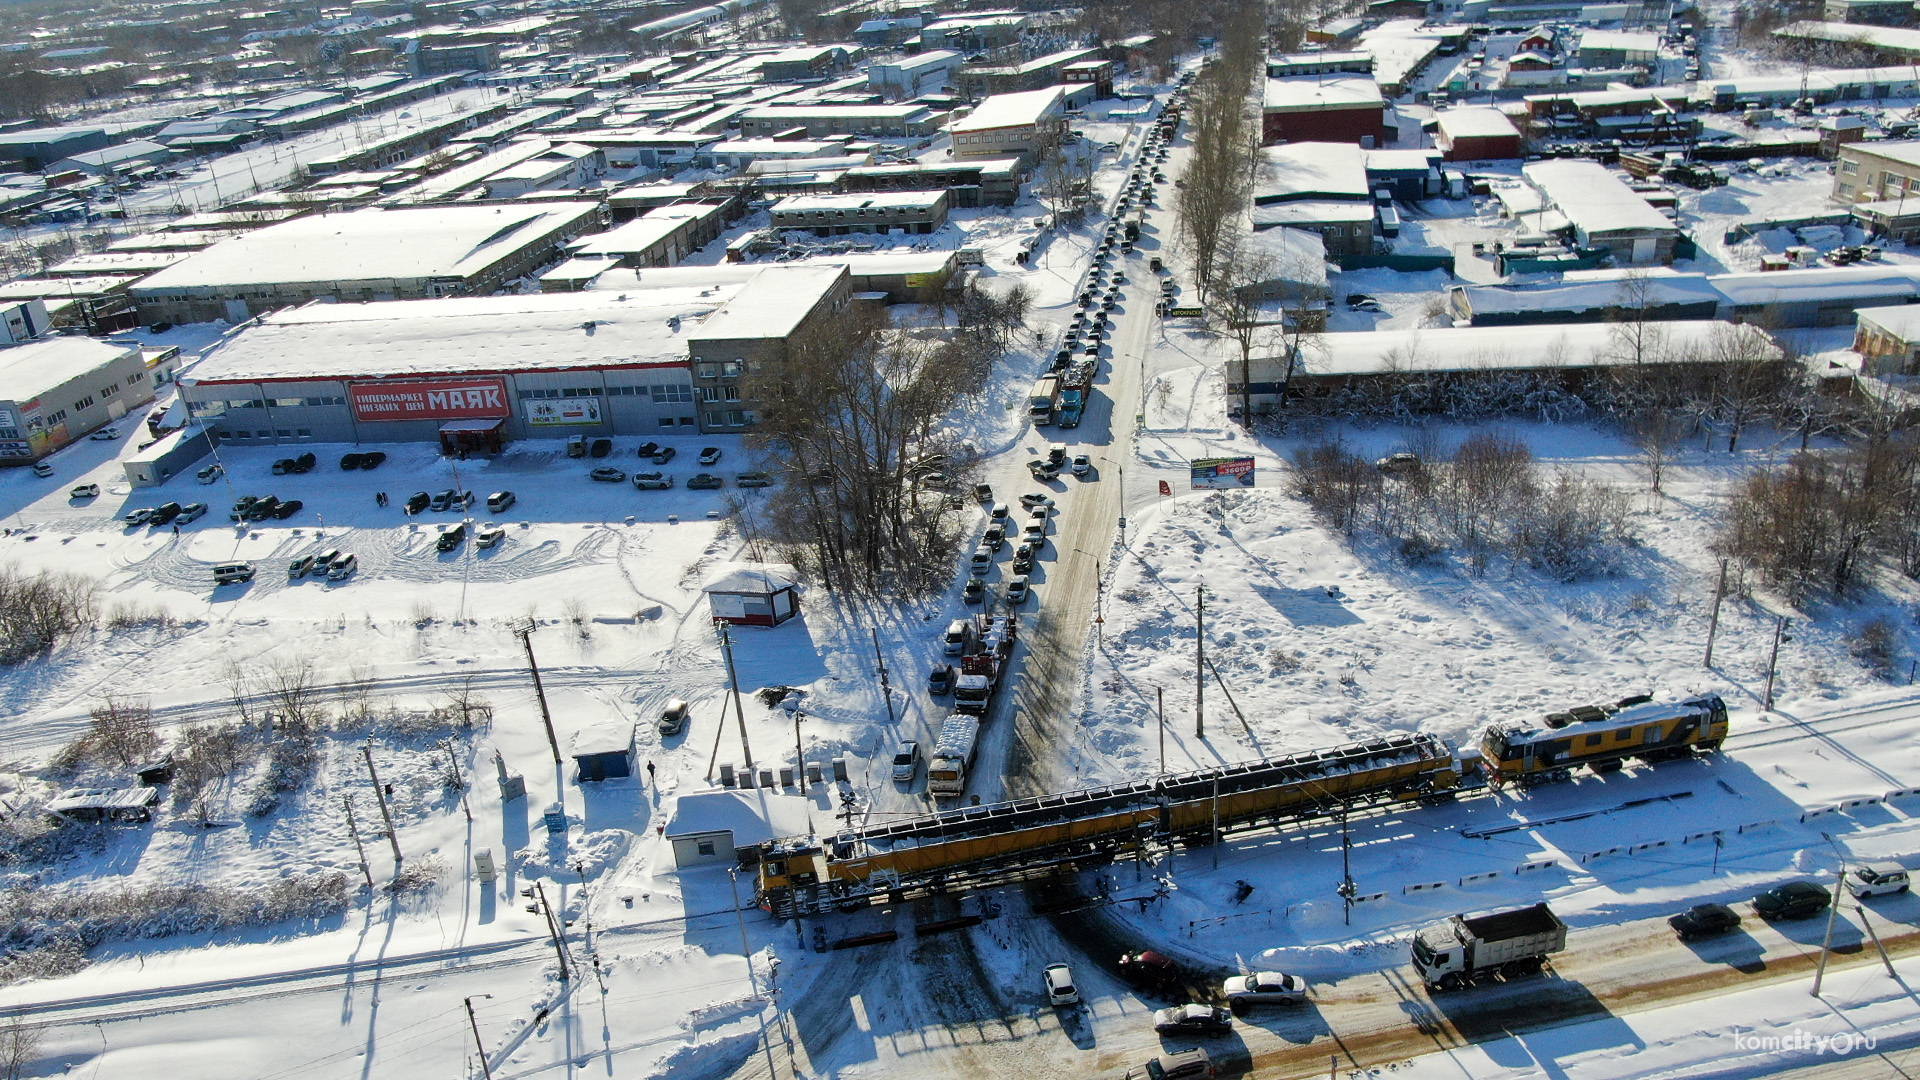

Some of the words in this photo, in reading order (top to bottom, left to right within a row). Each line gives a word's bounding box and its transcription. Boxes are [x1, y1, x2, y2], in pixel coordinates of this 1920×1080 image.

[356, 393, 423, 403] ГИПЕРМАРКЕТ
[427, 390, 503, 410] МАЯК
[358, 402, 400, 413] НИЗКИХ
[405, 402, 425, 411] ЦЕН
